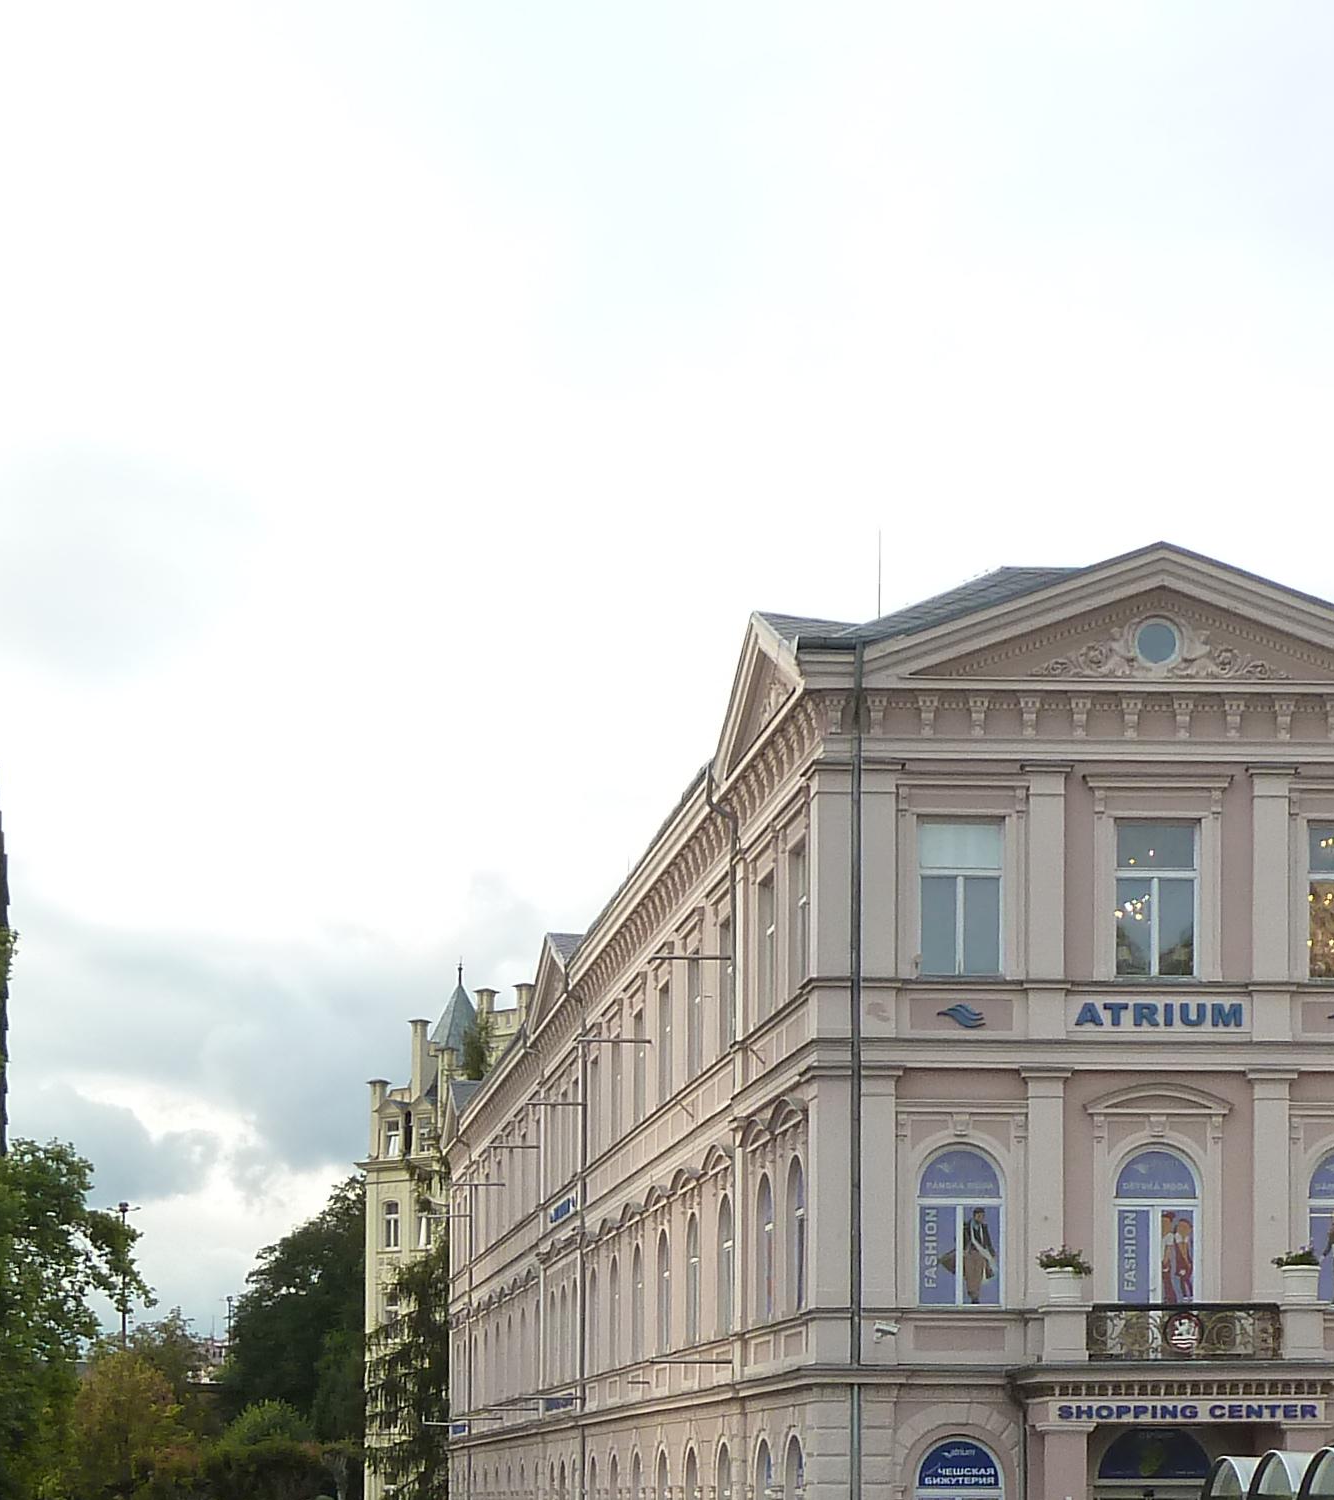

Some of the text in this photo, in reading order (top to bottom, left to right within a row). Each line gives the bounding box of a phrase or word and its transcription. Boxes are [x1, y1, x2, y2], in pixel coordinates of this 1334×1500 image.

[1074, 1002, 1243, 1027] ATRIUM
[925, 1208, 937, 1288] FASHION
[1124, 1212, 1137, 1291] FASHION
[1057, 1403, 1318, 1420] SHOPPING CENTER
[924, 1476, 995, 1485] БИЖУТЕРИЯ
[937, 1467, 995, 1475] ЧЕШСКАЯ
